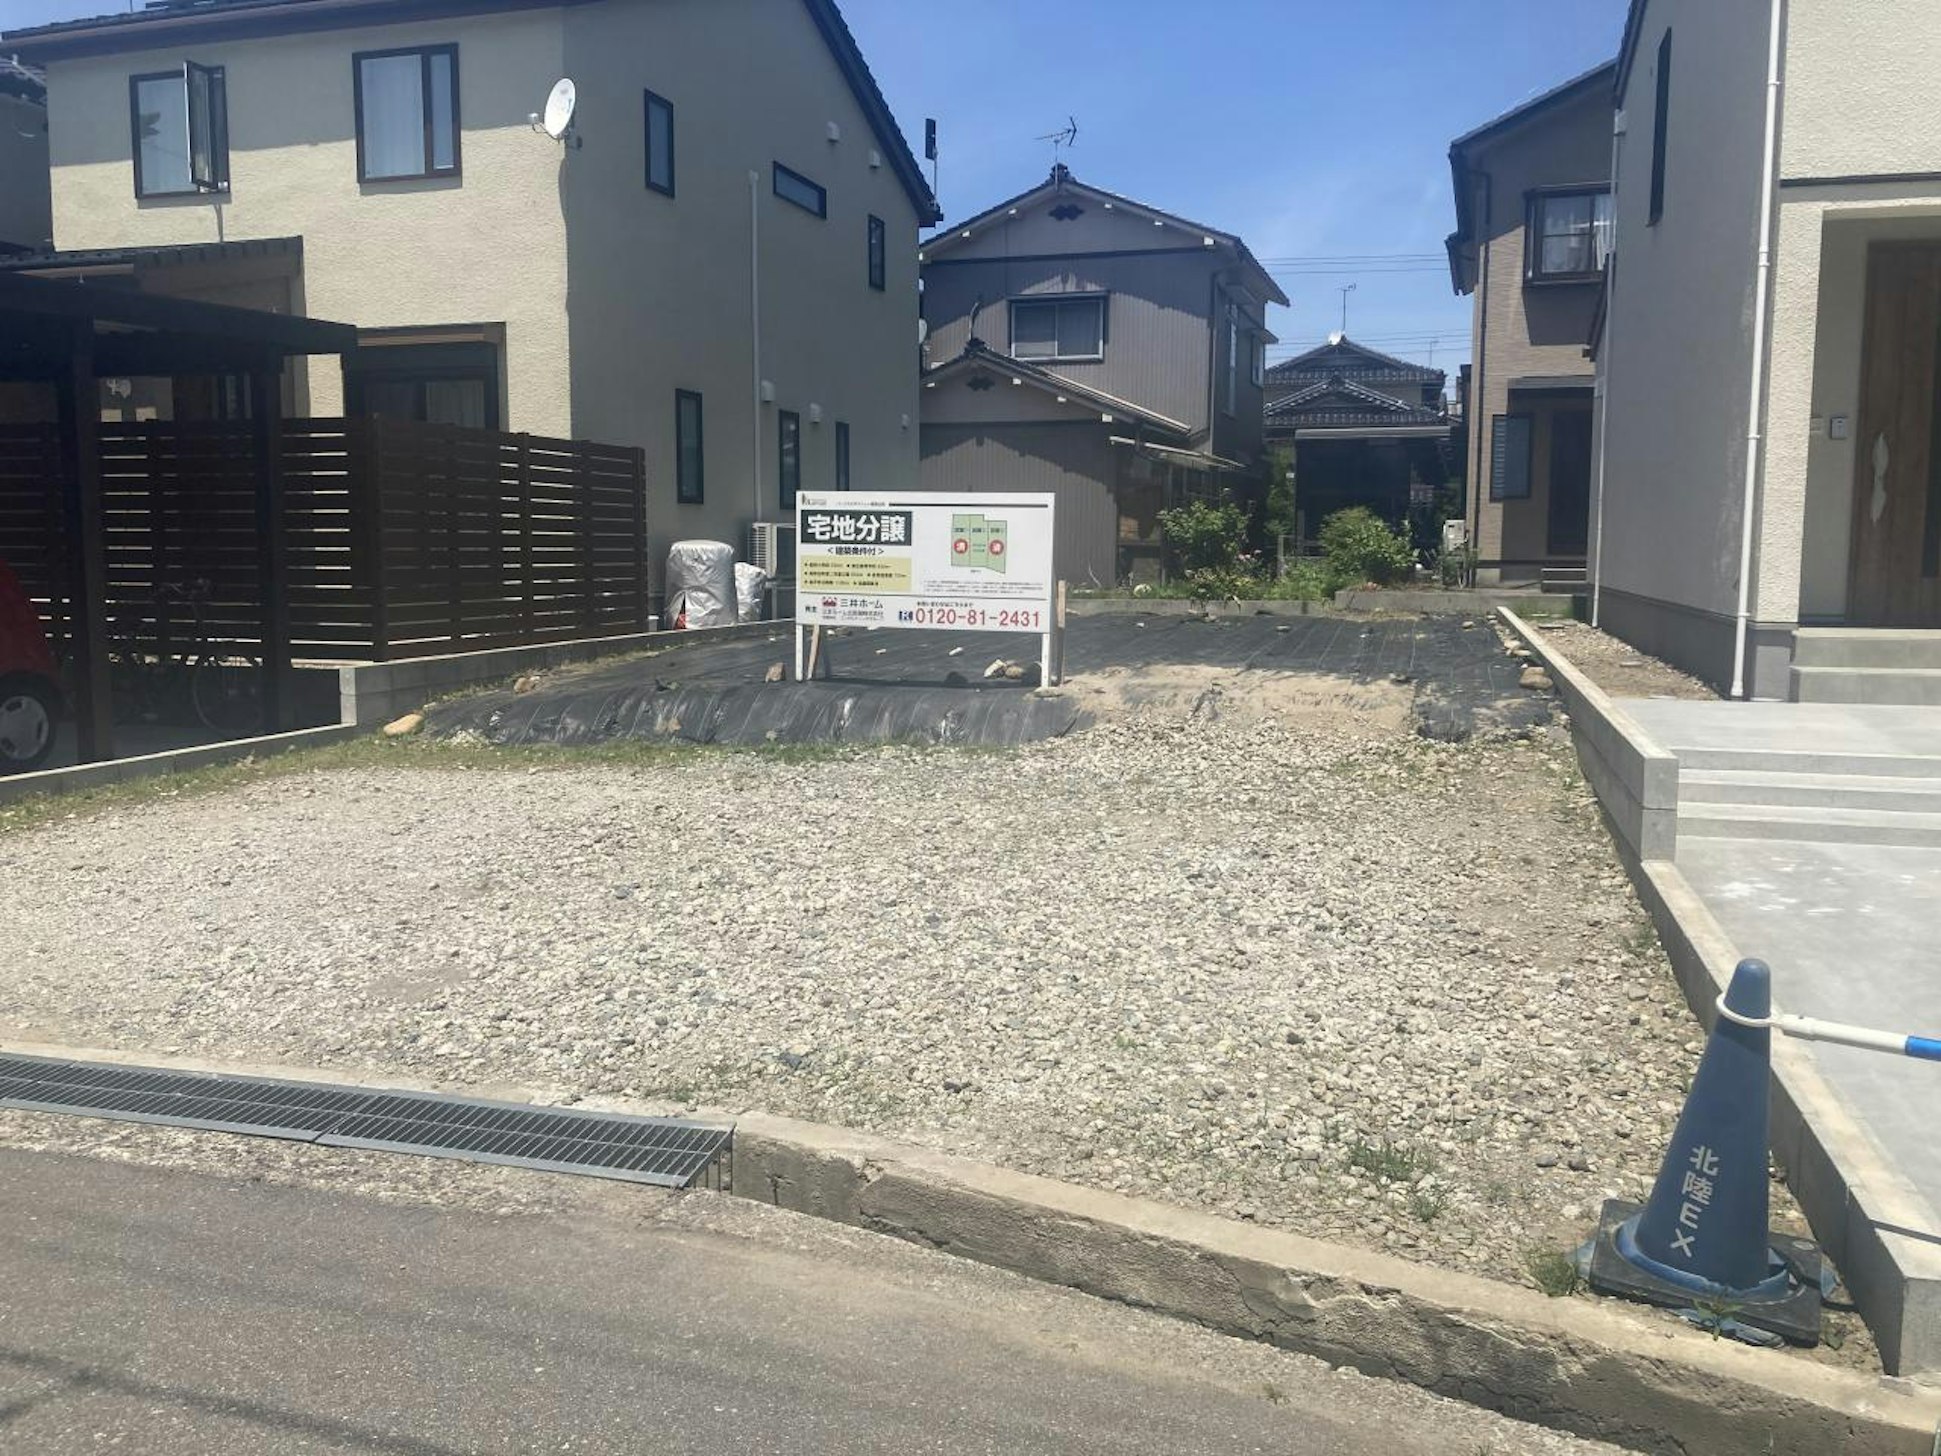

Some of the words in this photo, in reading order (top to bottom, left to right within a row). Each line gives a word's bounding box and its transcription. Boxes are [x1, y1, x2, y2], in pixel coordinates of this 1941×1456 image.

[807, 513, 906, 542] 宅地分譲
[840, 598, 883, 609] 三井ホーム
[915, 607, 1040, 628] 0120-81-2431
[1670, 1146, 1719, 1258] 北陸EX
